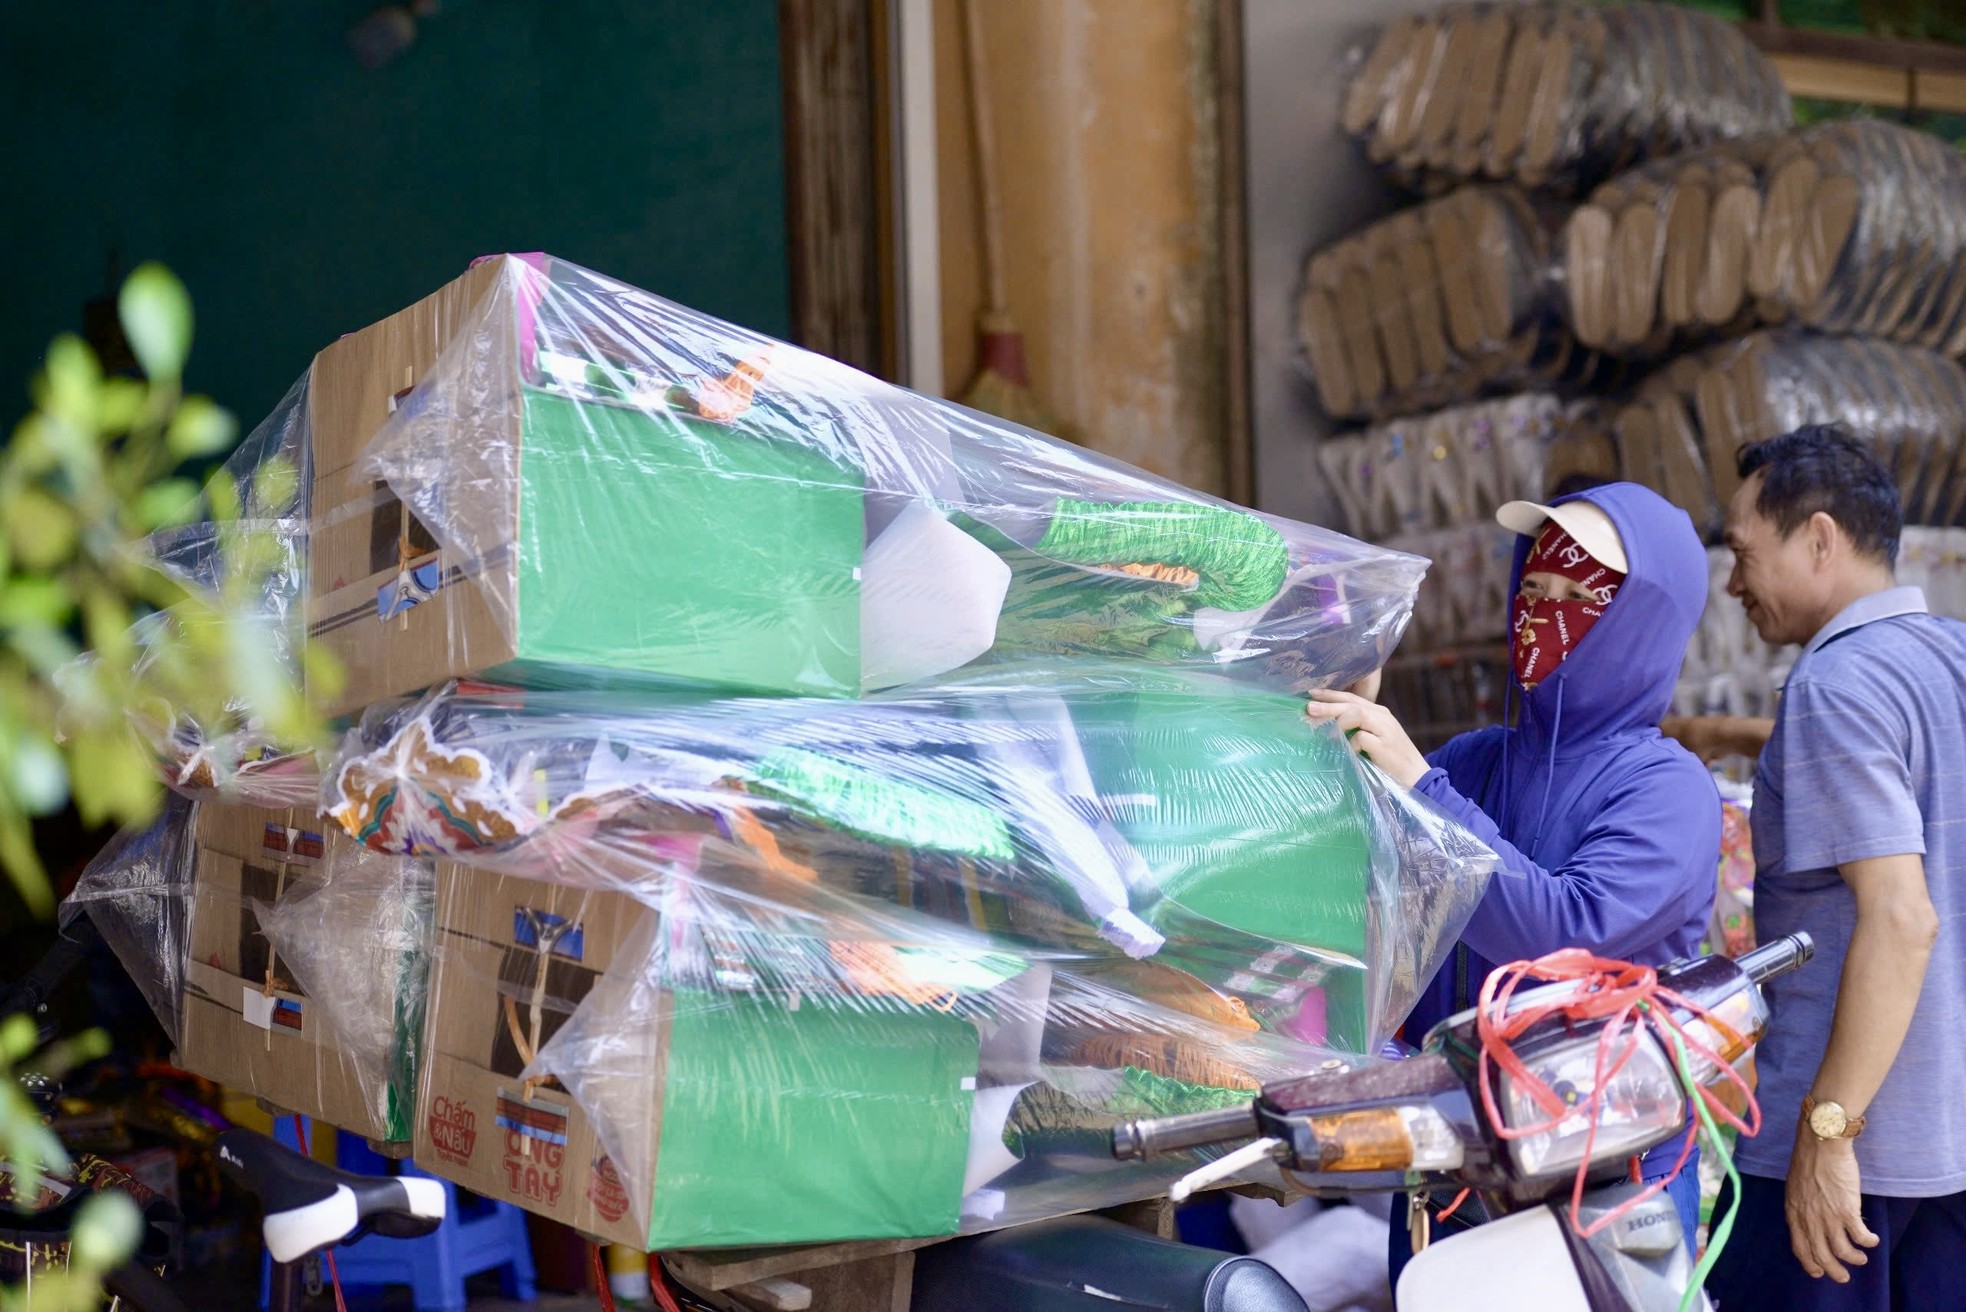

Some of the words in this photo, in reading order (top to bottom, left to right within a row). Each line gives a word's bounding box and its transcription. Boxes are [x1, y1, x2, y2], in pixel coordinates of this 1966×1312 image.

[1555, 610, 1570, 645] CHANEL
[1582, 606, 1604, 617] CHA
[1523, 647, 1540, 678] CHANEL
[433, 1095, 475, 1130] Chấm
